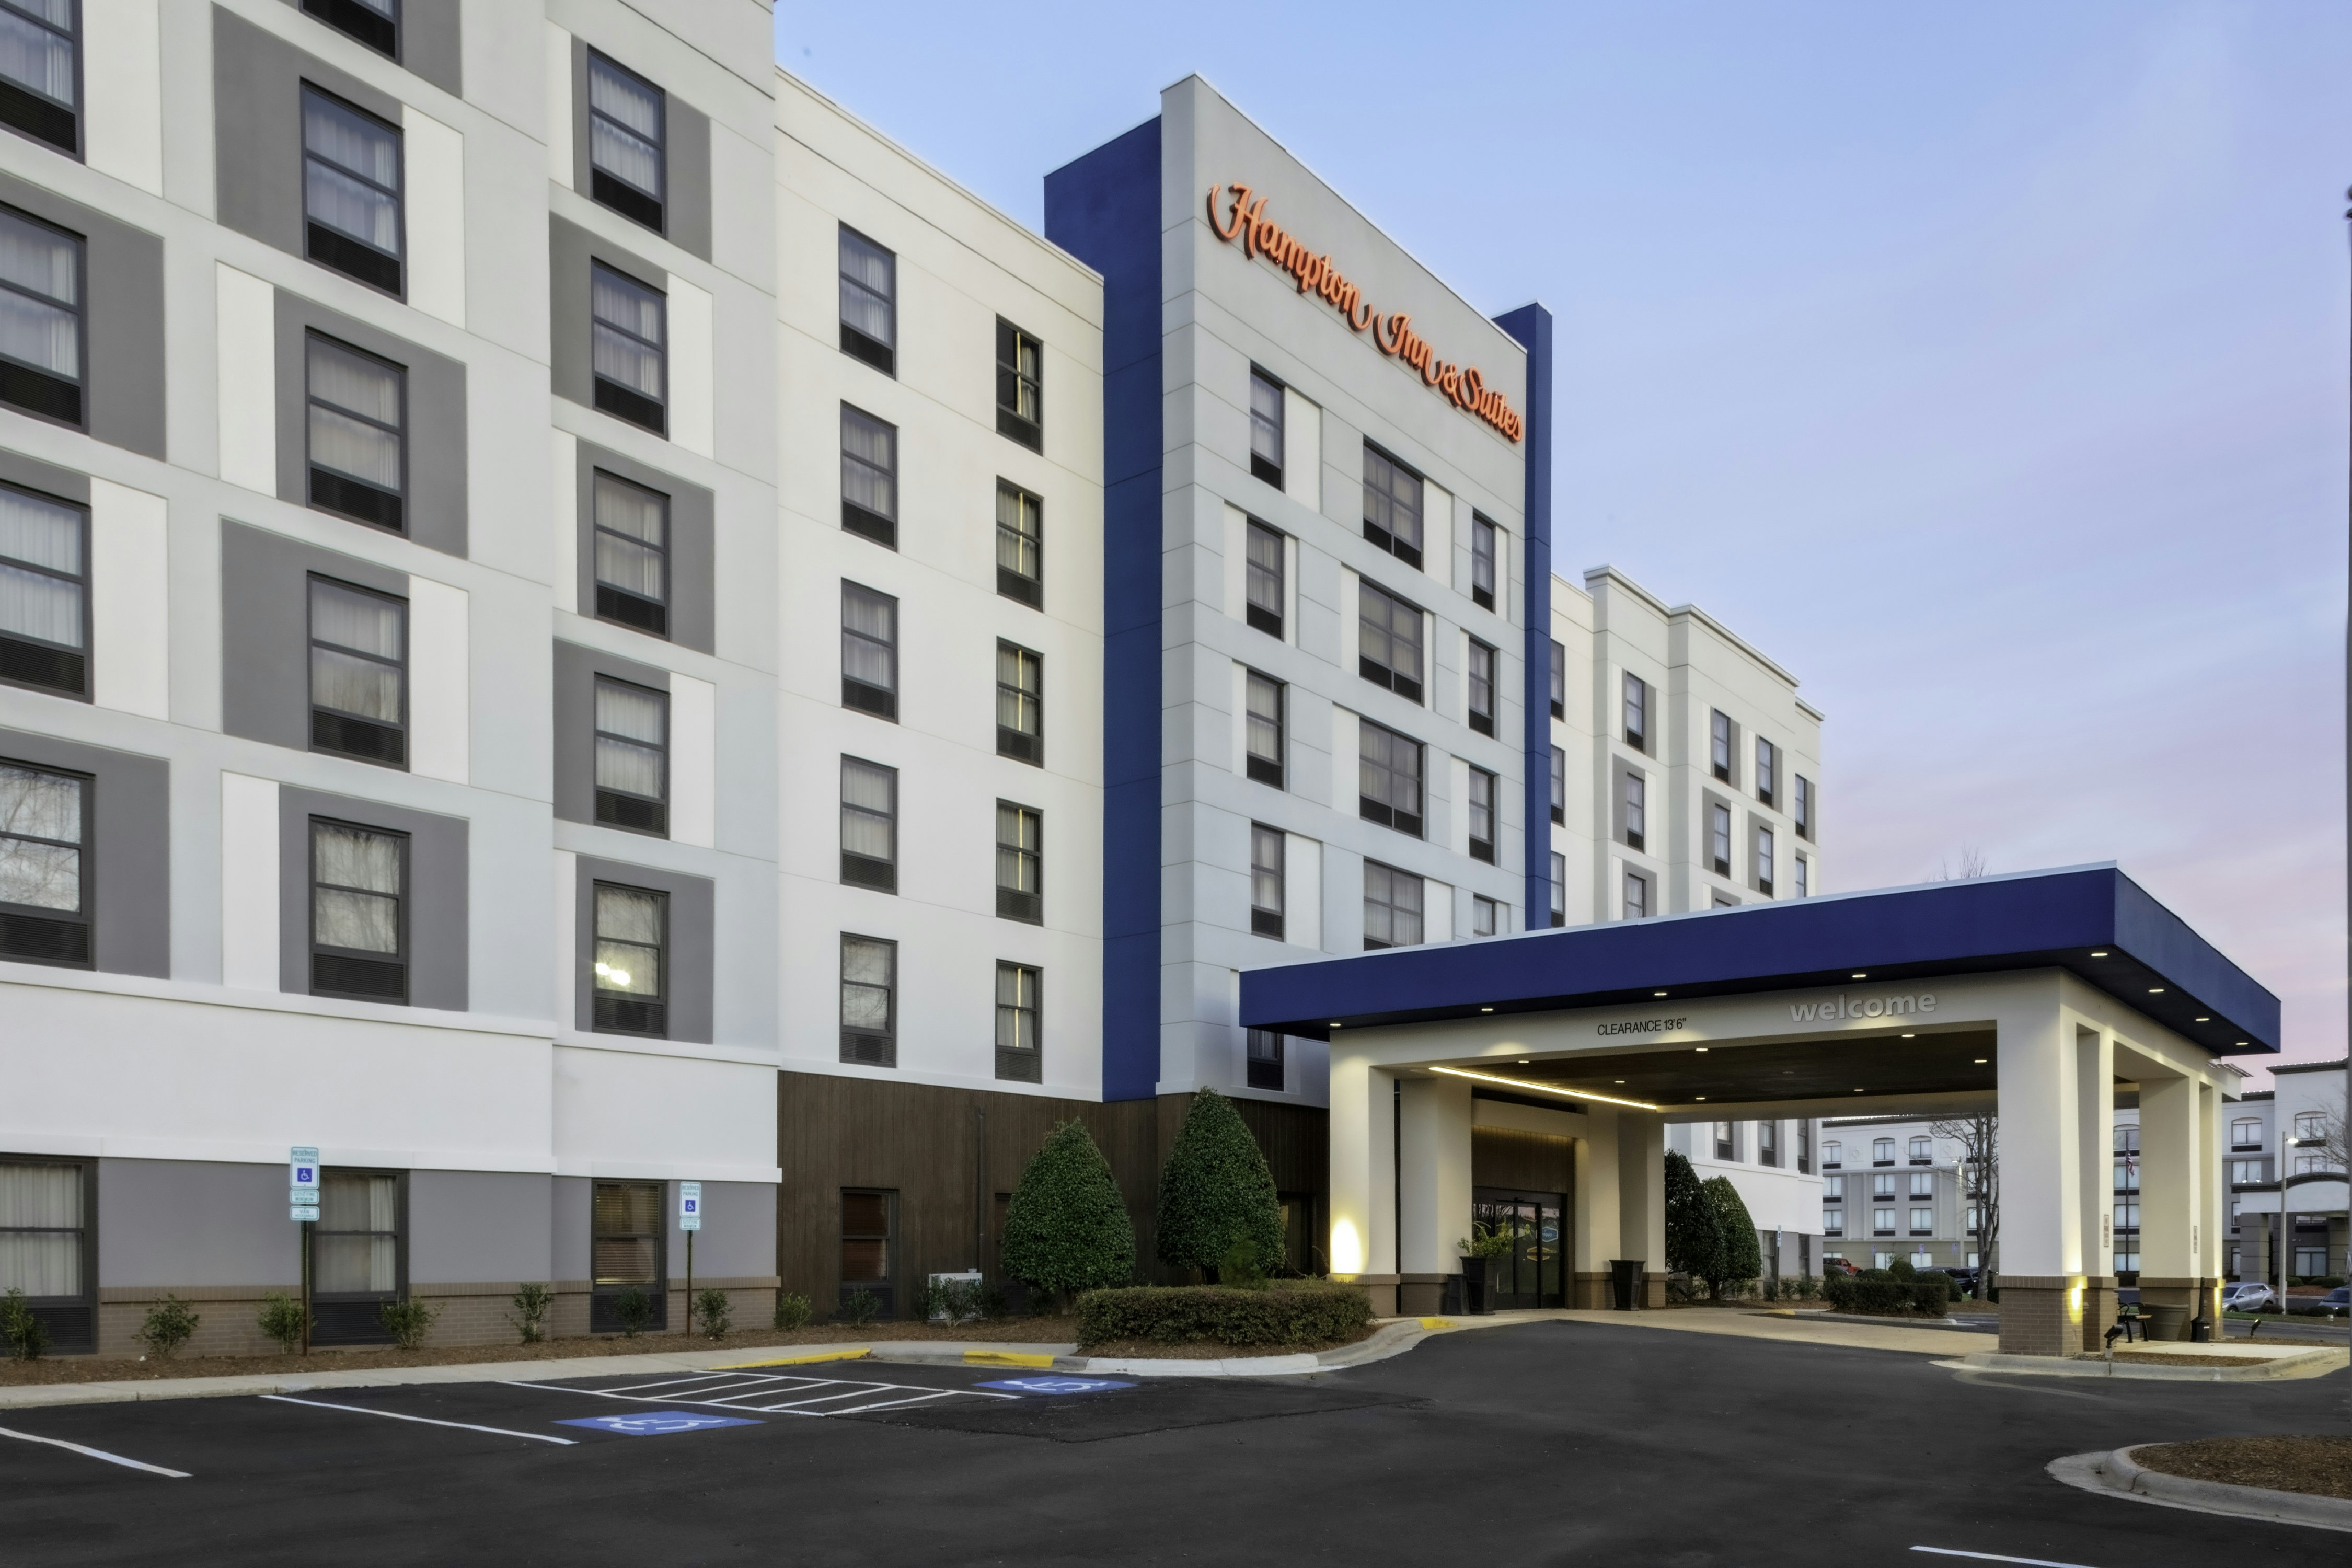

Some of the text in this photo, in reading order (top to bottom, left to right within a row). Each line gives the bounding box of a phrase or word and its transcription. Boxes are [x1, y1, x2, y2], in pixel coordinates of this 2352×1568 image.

[1207, 182, 1522, 444] Hampton Inn & Suites
[1789, 993, 1936, 1022] welcome
[1597, 1020, 1662, 1036] CLEARANCE
